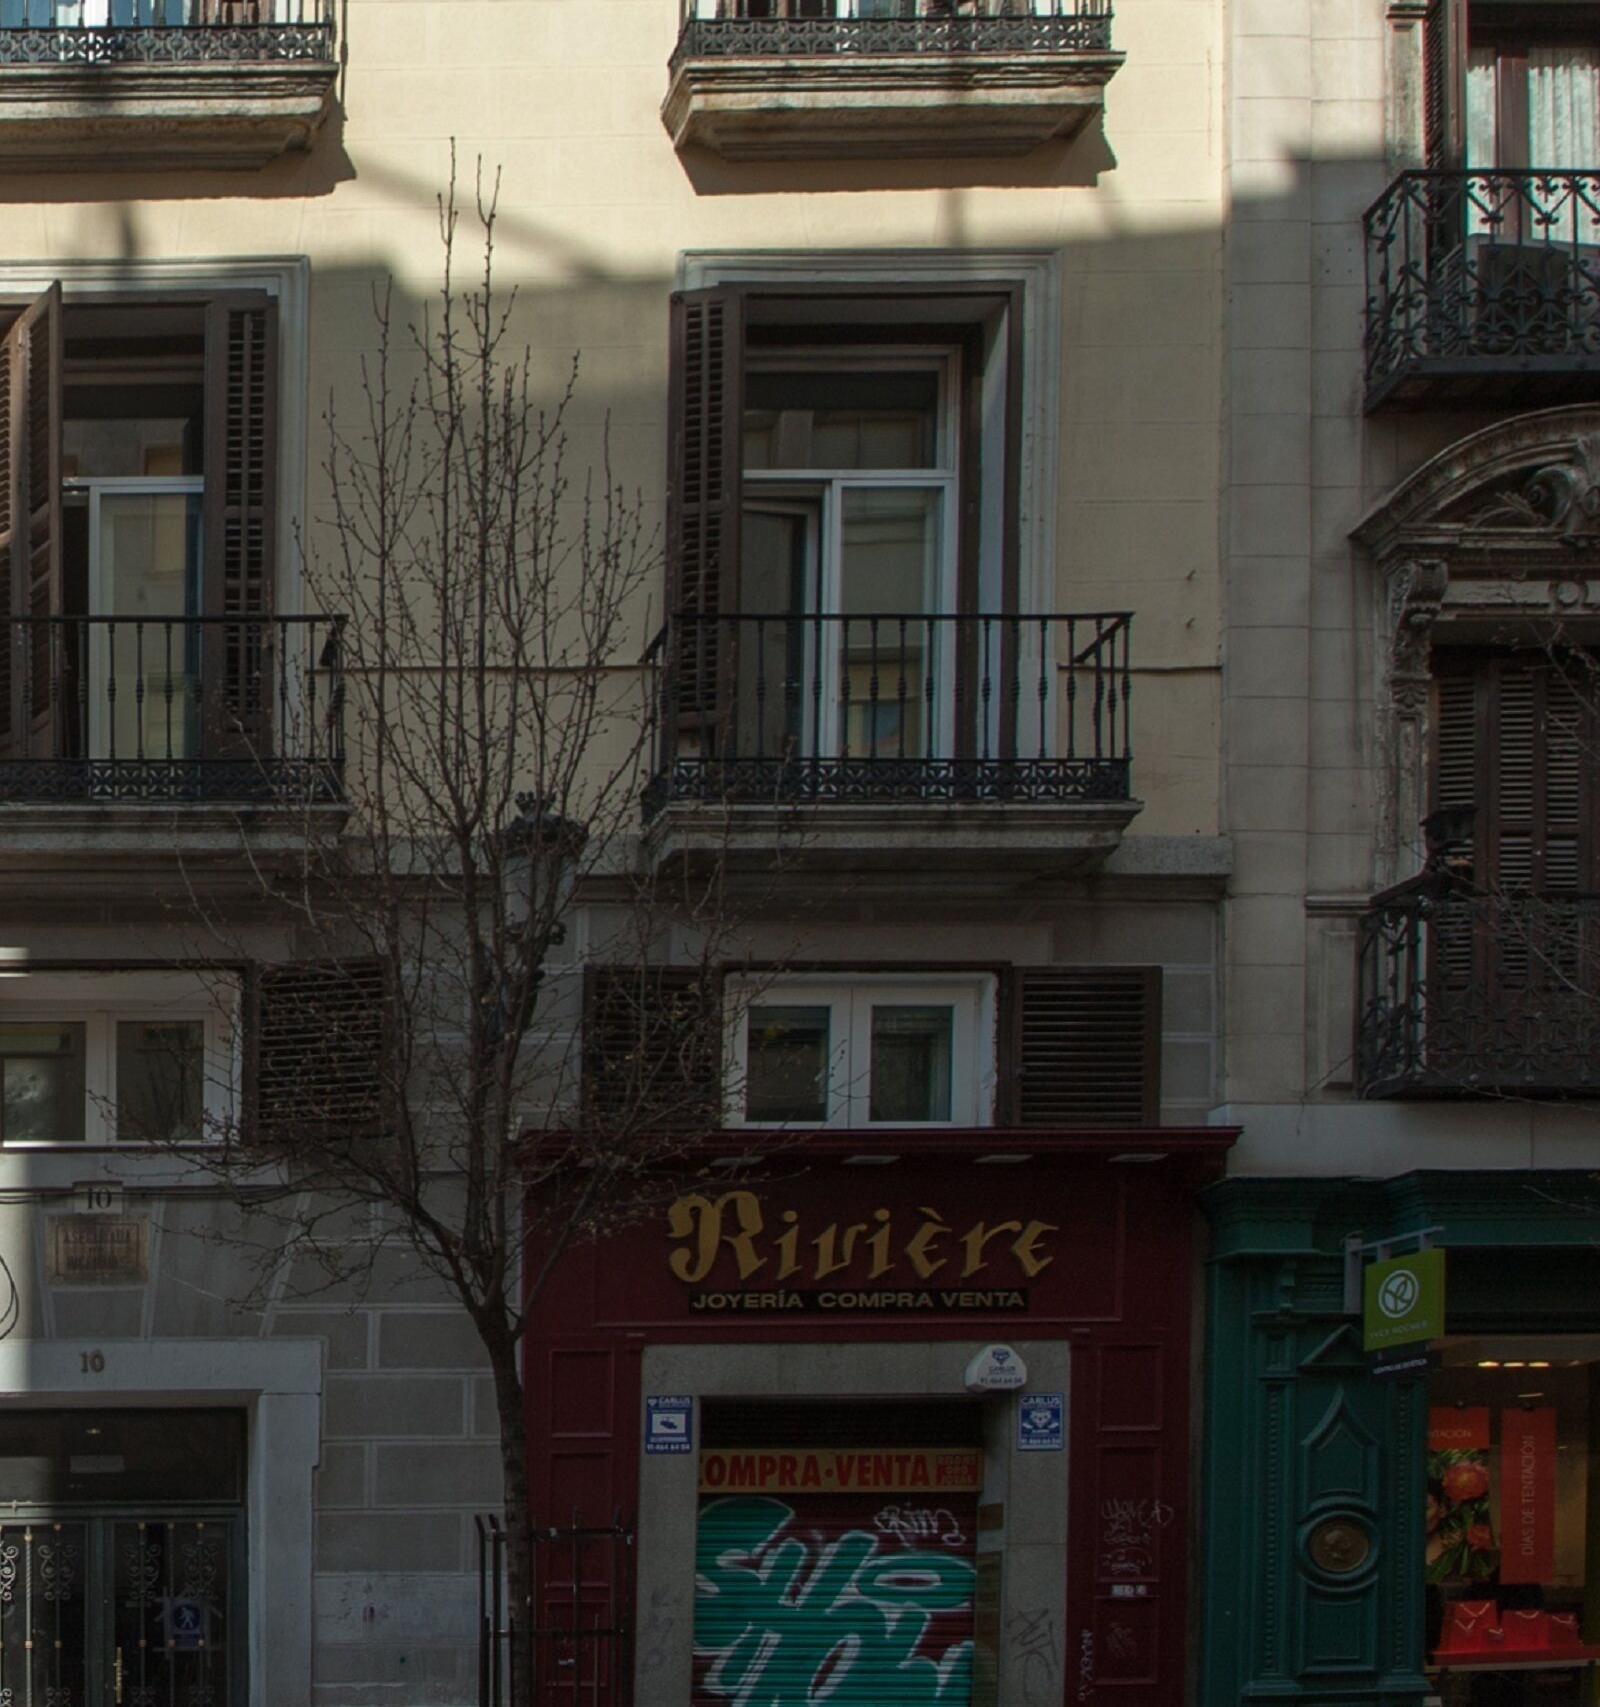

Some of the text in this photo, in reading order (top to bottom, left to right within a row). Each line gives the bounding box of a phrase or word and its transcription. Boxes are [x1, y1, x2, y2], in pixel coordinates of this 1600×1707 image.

[87, 1187, 113, 1209] 10
[666, 1190, 1060, 1283] Rivière
[691, 1288, 1026, 1309] JOYERÍA COMPRA VENTA
[79, 1349, 106, 1373] 10
[658, 1396, 691, 1404] CARLUS
[1020, 1396, 1061, 1405] CARLUS
[699, 1454, 823, 1487] OMPRA
[1521, 1509, 1535, 1525] DE
